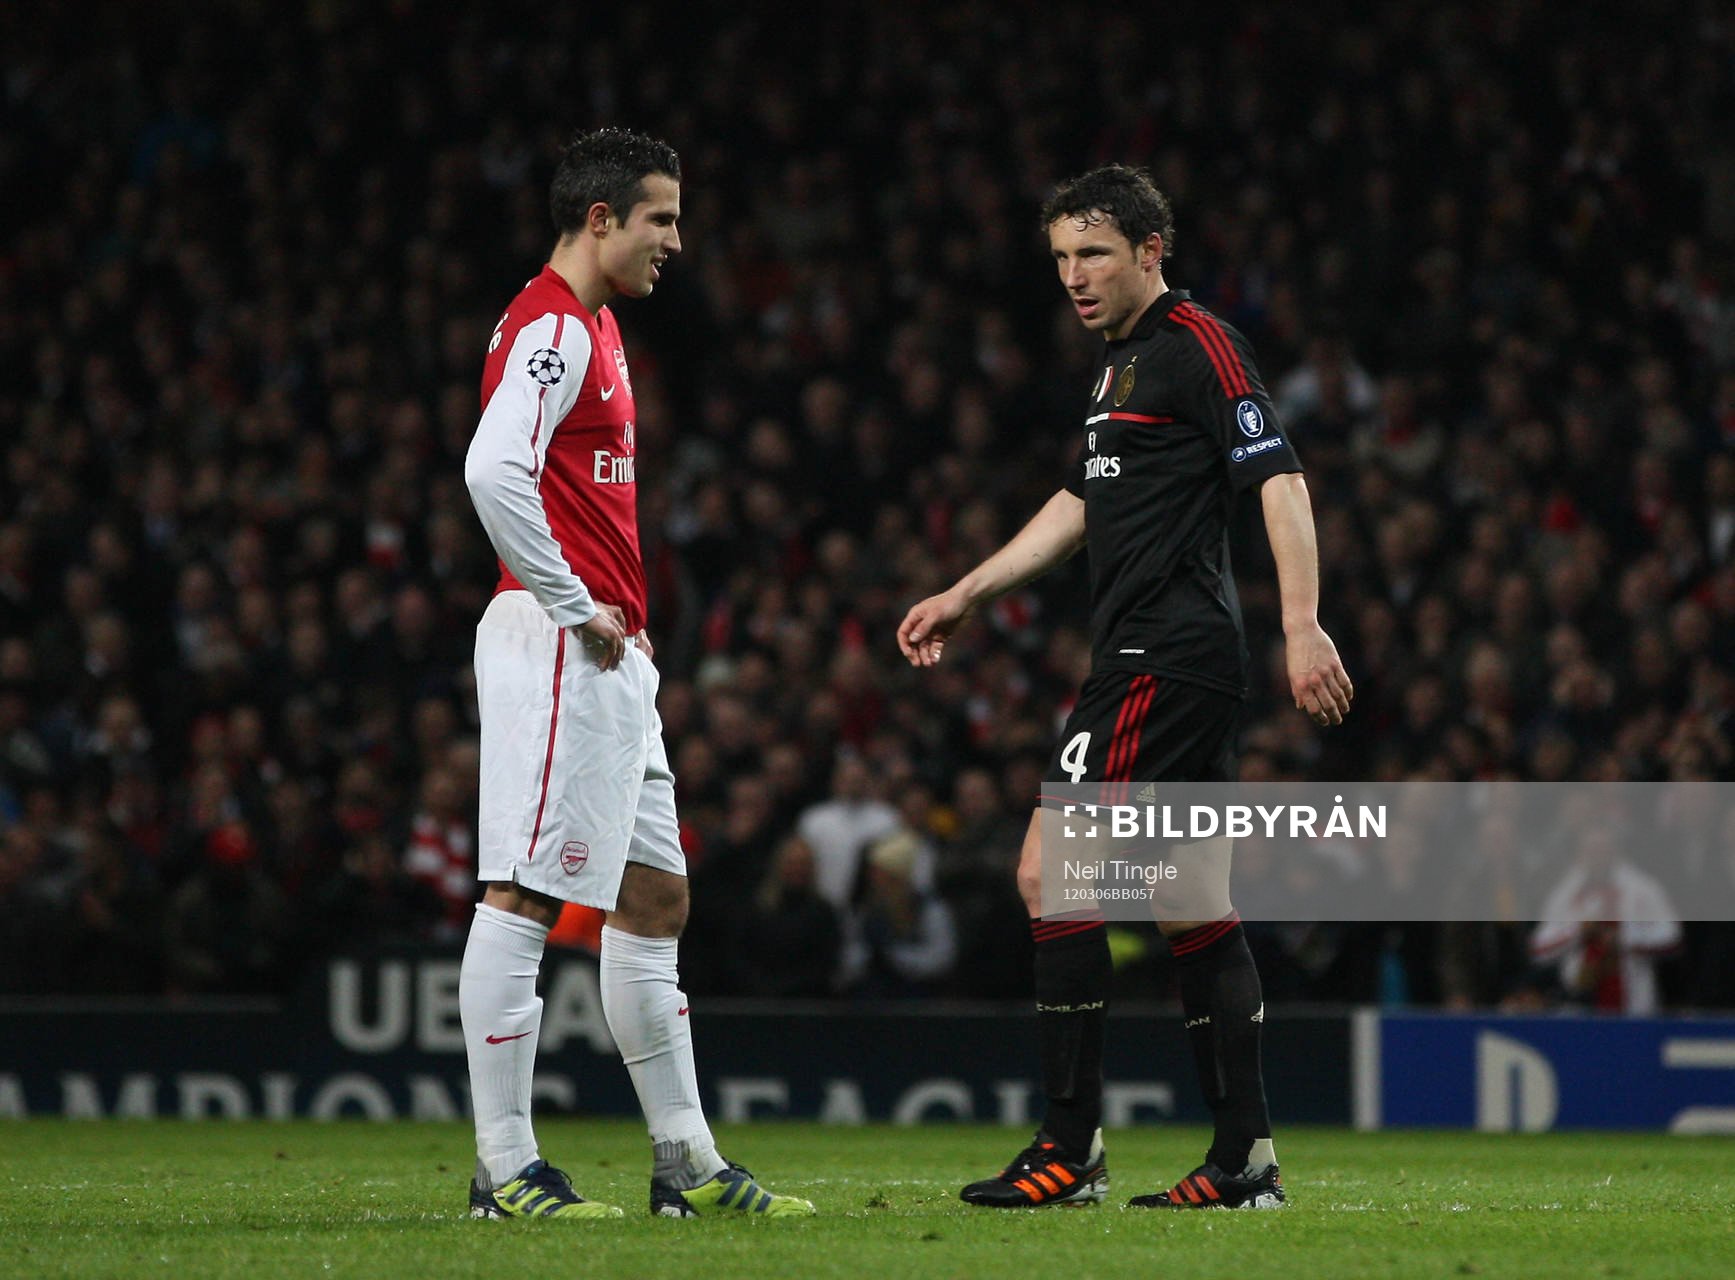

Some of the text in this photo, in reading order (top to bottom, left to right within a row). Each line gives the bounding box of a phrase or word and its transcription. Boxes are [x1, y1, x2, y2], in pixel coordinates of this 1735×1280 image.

[1246, 437, 1282, 454] RESPECT
[1060, 731, 1092, 784] 4
[328, 959, 618, 1054] UEA
